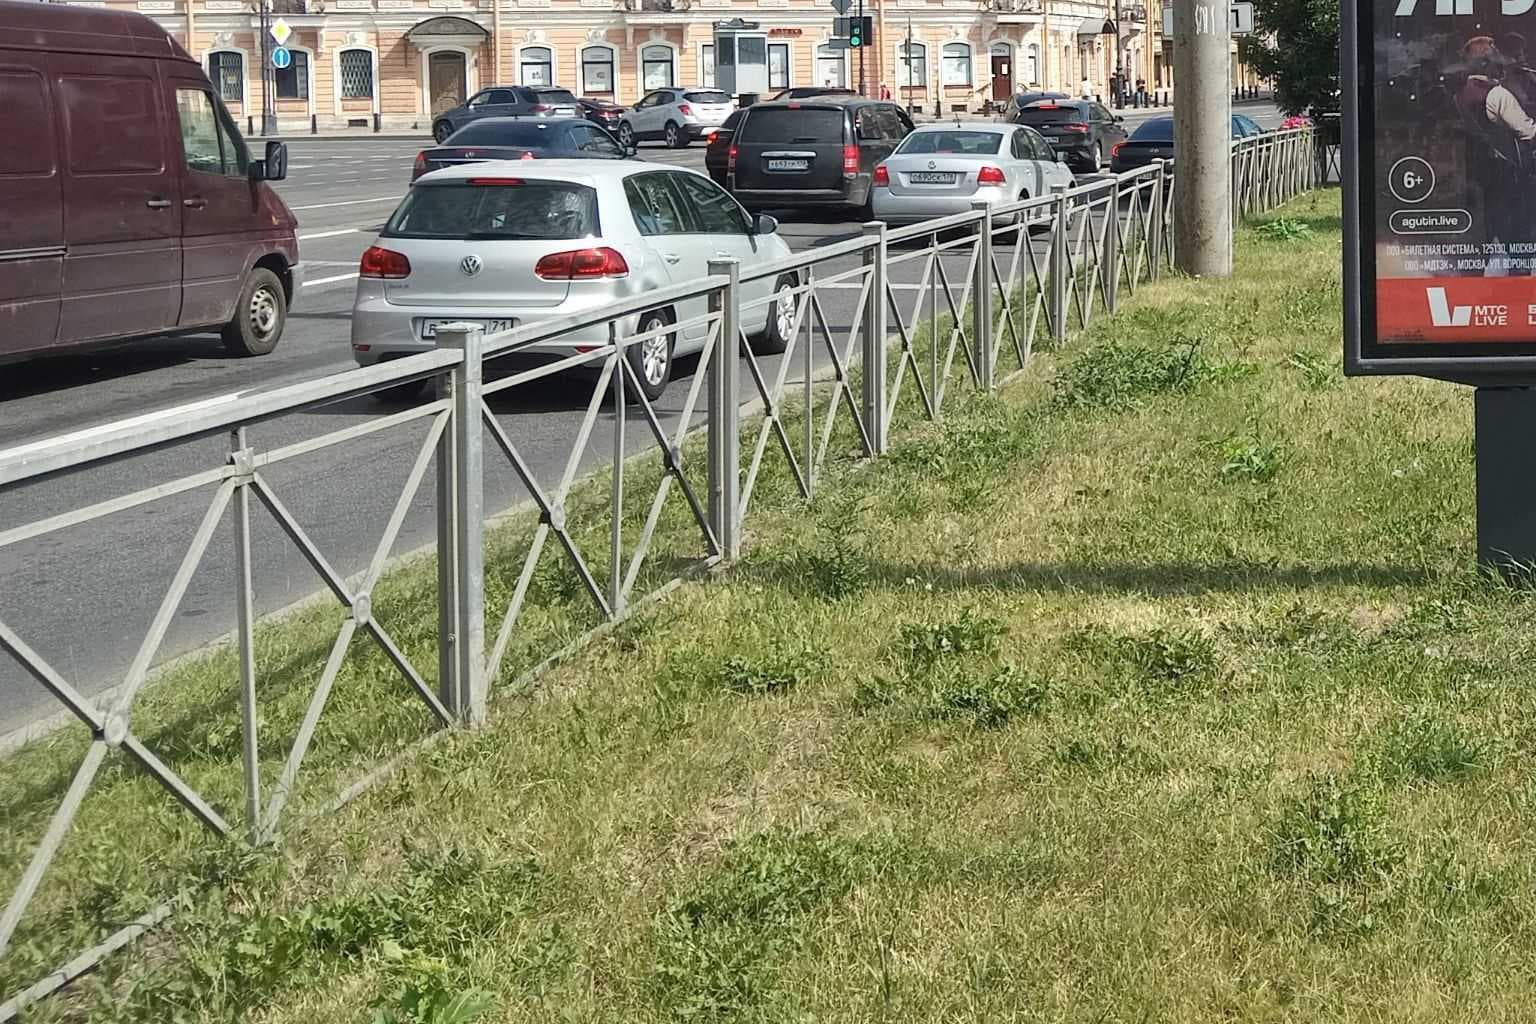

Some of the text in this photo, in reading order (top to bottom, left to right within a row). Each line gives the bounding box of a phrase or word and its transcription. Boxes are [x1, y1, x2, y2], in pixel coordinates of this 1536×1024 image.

[1403, 171, 1424, 189] 6+
[1402, 216, 1458, 229] agutin.live
[1474, 315, 1508, 326] LIVE
